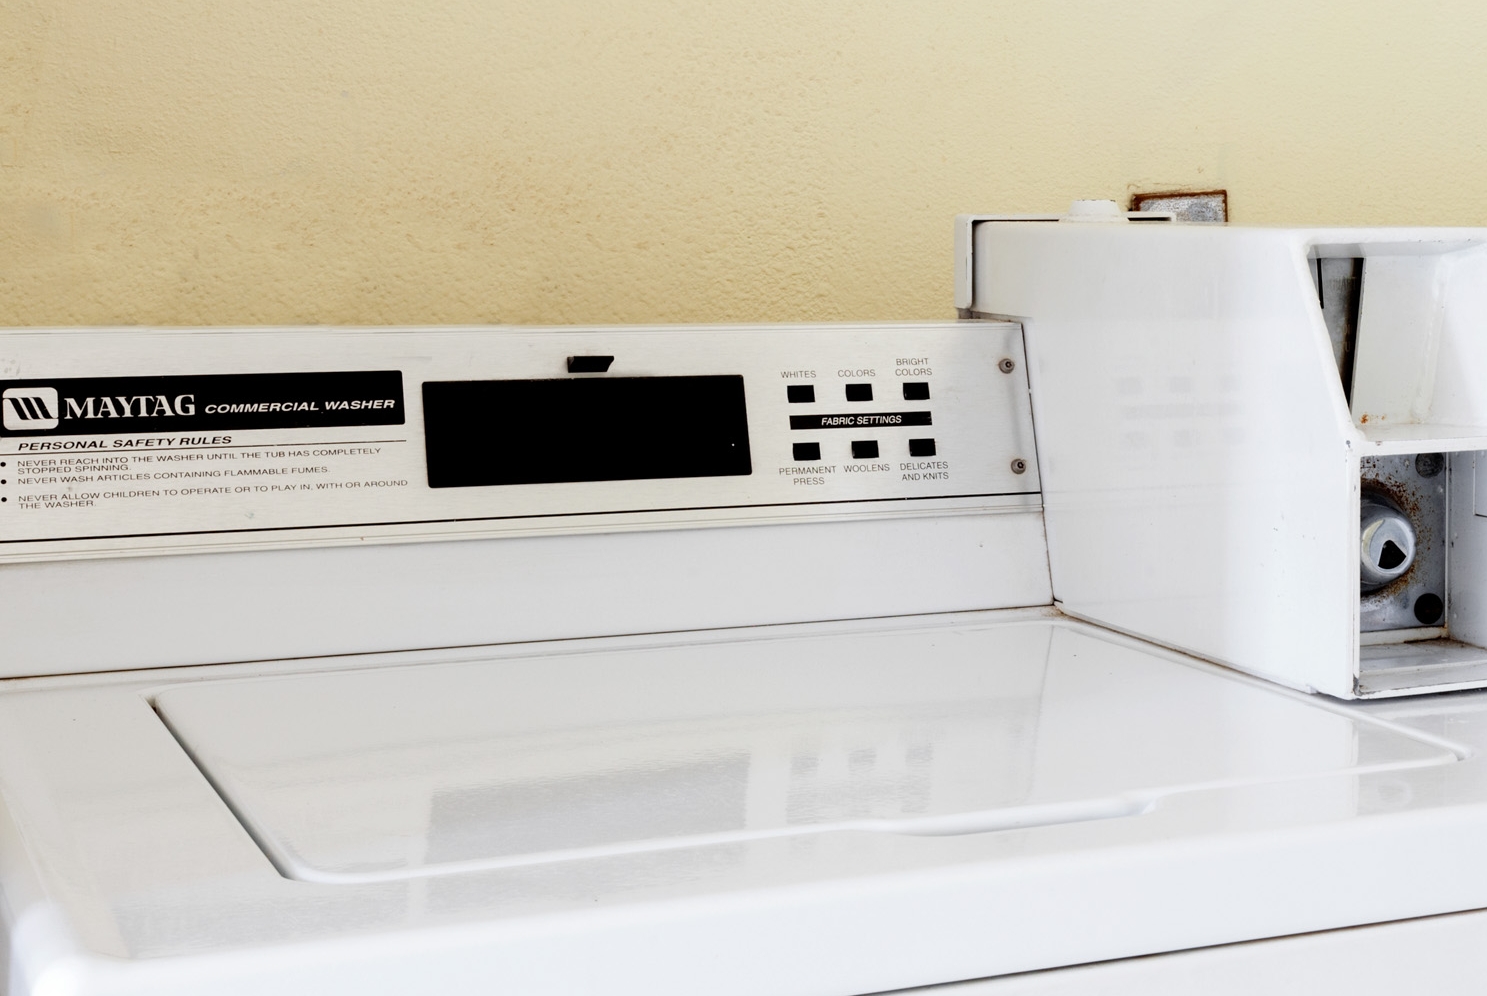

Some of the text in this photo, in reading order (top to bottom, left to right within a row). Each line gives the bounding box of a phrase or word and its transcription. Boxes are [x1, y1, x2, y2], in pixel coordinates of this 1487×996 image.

[896, 357, 929, 366] BRIGHT
[780, 370, 816, 379] WHITES
[837, 369, 876, 378] COLORS
[895, 367, 933, 377] COLORS
[64, 394, 196, 420] MAYTAG
[205, 399, 395, 414] COMMERCIAL WASHER
[821, 415, 902, 426] FABRIC SETTINGS
[18, 436, 232, 451] PERSONAL SAFETY RULES
[156, 454, 204, 462] WASHER
[312, 448, 381, 456] COMPLETELY
[18, 464, 131, 475] STOPPED SPINNING.
[778, 465, 837, 476] PERMANENT
[843, 463, 890, 473] WOOLENS
[900, 461, 949, 471] DELICATES
[61, 475, 94, 483] WASH
[97, 473, 151, 481] ARTICLES
[153, 470, 221, 479] CONTAINING
[224, 468, 288, 476] FLAMMABLE
[291, 466, 330, 474] FUMES.
[901, 471, 949, 481] AND KNITS
[793, 477, 825, 486] PRESS
[18, 494, 58, 502] NEVER
[61, 492, 104, 500] ALLOW
[104, 490, 160, 499] CHILDREN
[180, 487, 231, 496] OPERATE
[271, 484, 296, 492] PLAY
[316, 482, 343, 490] WITH
[44, 500, 96, 508] WASHER.
